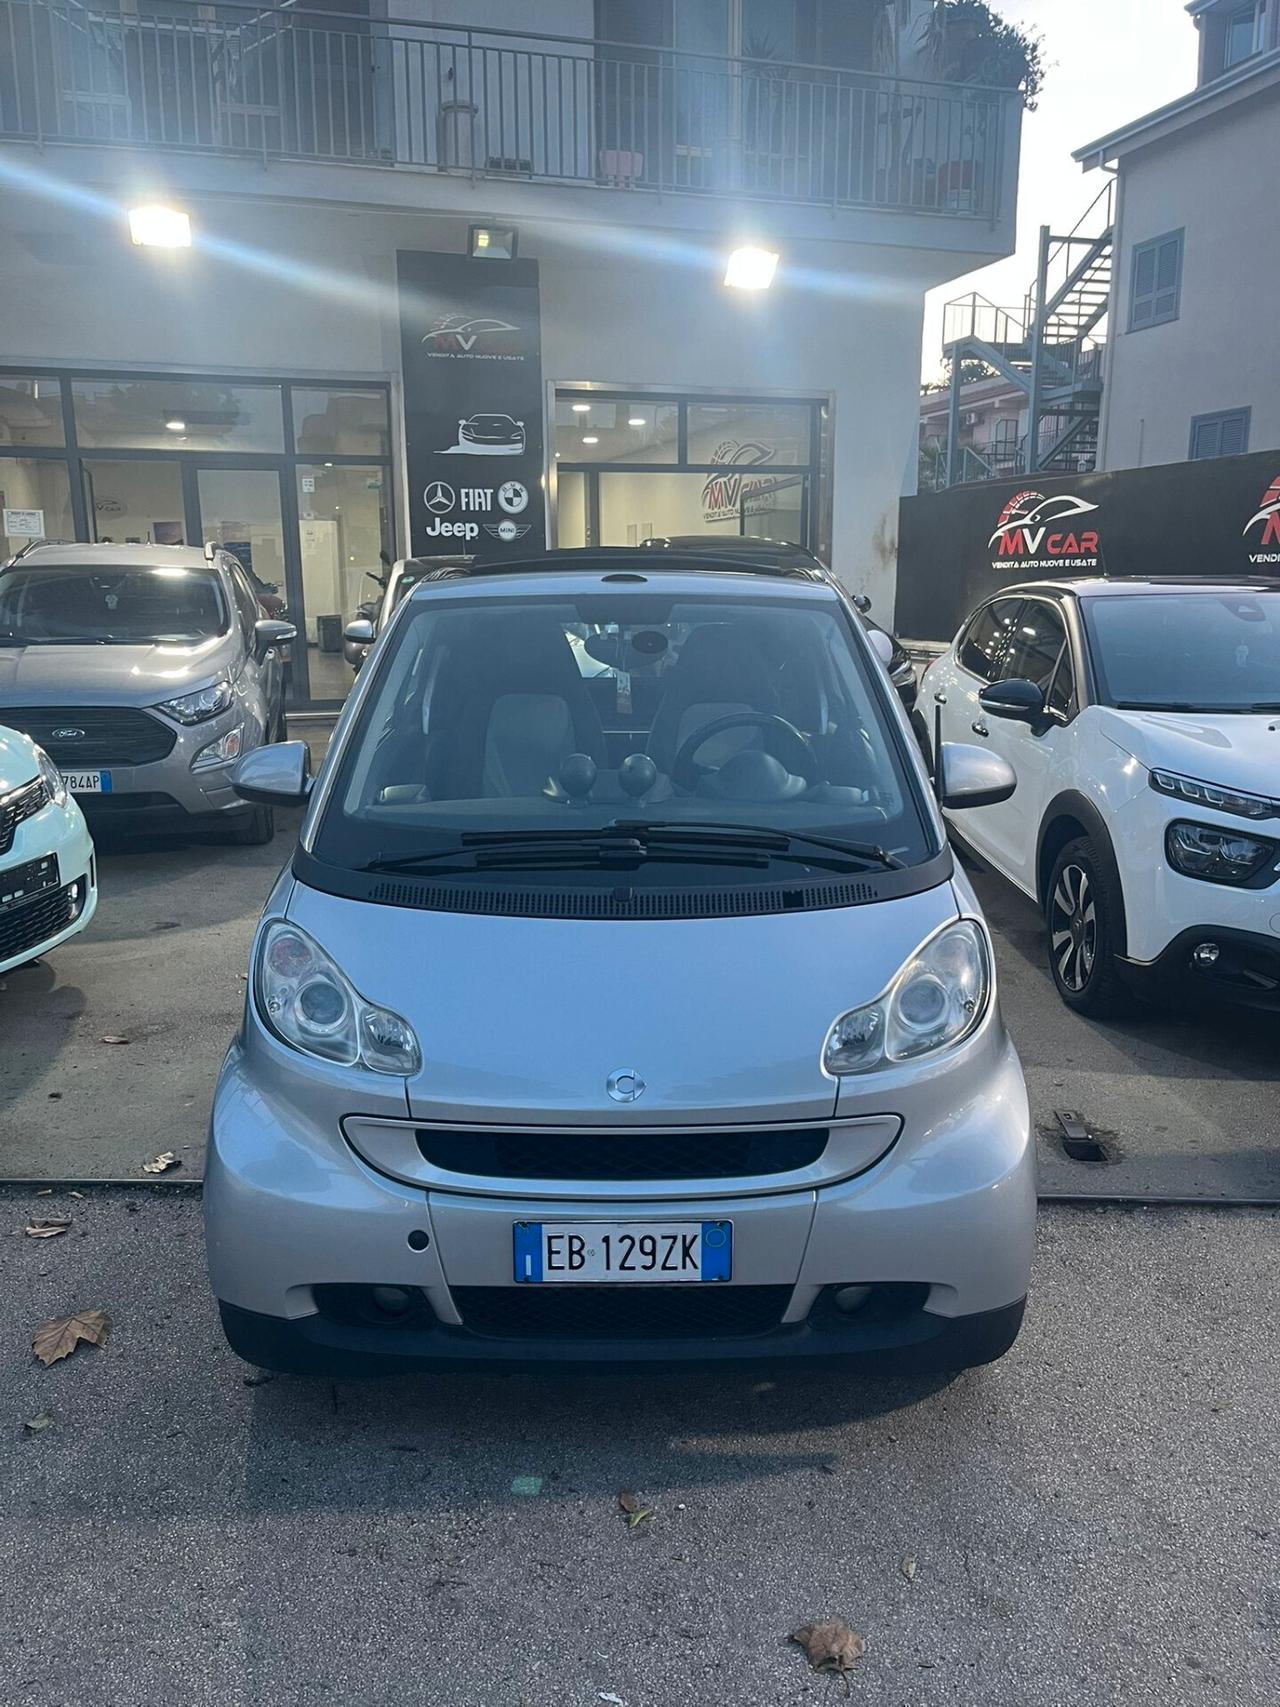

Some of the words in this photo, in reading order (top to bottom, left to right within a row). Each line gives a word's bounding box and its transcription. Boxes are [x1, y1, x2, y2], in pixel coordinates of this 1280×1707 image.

[460, 488, 494, 511] FIAT
[426, 517, 479, 540] Jeep
[999, 527, 1046, 556] MV
[1047, 531, 1099, 555] CAR
[992, 561, 1019, 569] VENDITA
[1020, 560, 1039, 569] AUTO
[1039, 559, 1064, 568] NUOVE
[1065, 559, 1070, 567] E
[1071, 558, 1097, 567] USATE
[547, 1234, 586, 1271] EB
[601, 1233, 699, 1271] 129ZK
